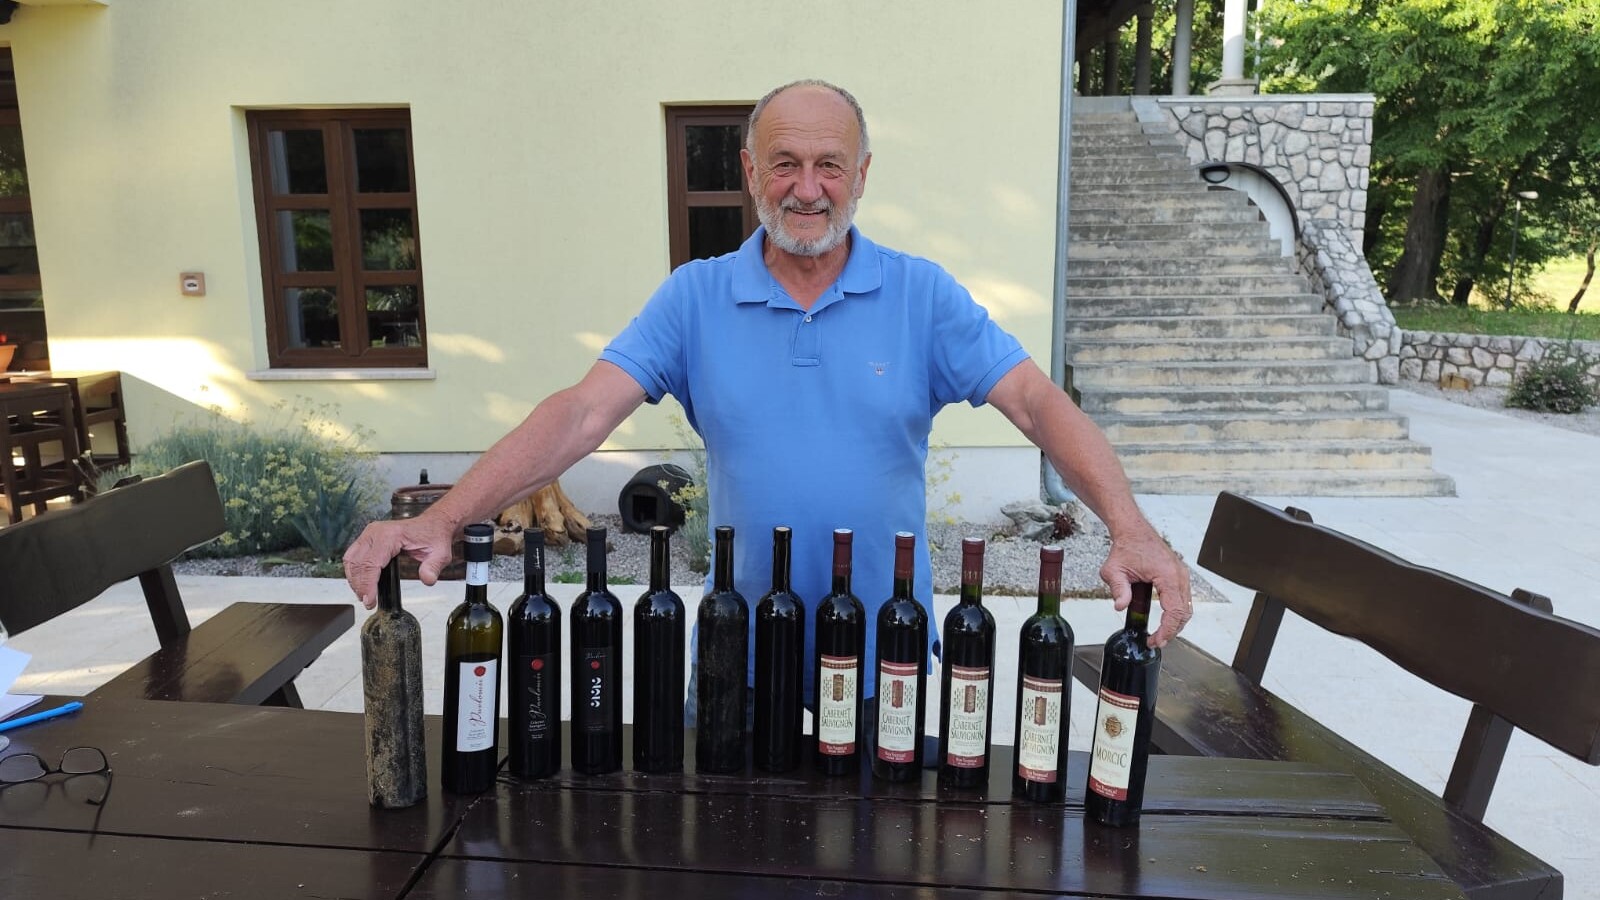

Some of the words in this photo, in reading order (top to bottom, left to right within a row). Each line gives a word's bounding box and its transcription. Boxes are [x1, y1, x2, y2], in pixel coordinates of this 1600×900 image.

[823, 707, 852, 720] CABERNET
[882, 713, 910, 726] CABERNET
[821, 716, 853, 729] SAUVIGNON
[880, 722, 912, 736] SAUVIGNON
[953, 718, 982, 731] CABERNET
[950, 729, 985, 741] SAUVIGNON
[1024, 729, 1054, 745] CABERNET
[1022, 739, 1056, 755] SAUVIGNON
